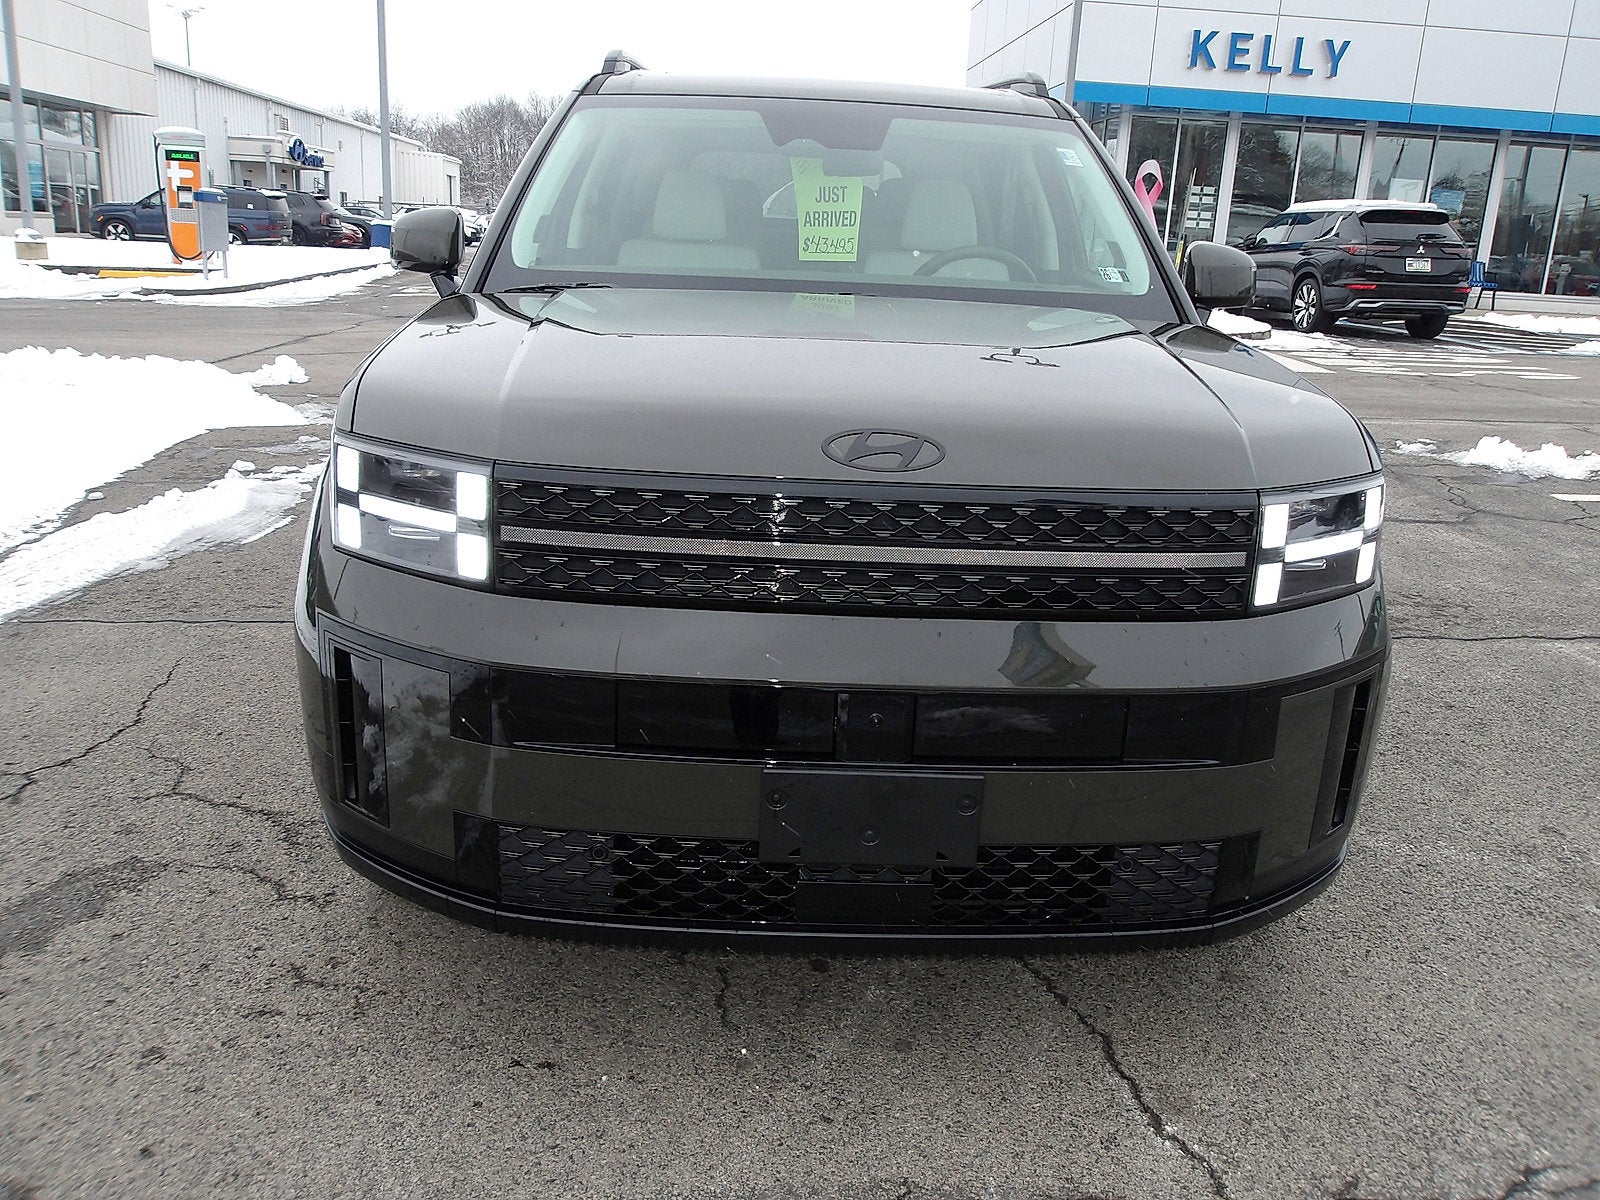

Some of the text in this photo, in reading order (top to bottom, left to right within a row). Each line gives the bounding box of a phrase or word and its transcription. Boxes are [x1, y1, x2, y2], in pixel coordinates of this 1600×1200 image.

[1187, 29, 1352, 79] KELLY
[815, 185, 848, 203] JUST
[803, 210, 857, 228] ARRIVED
